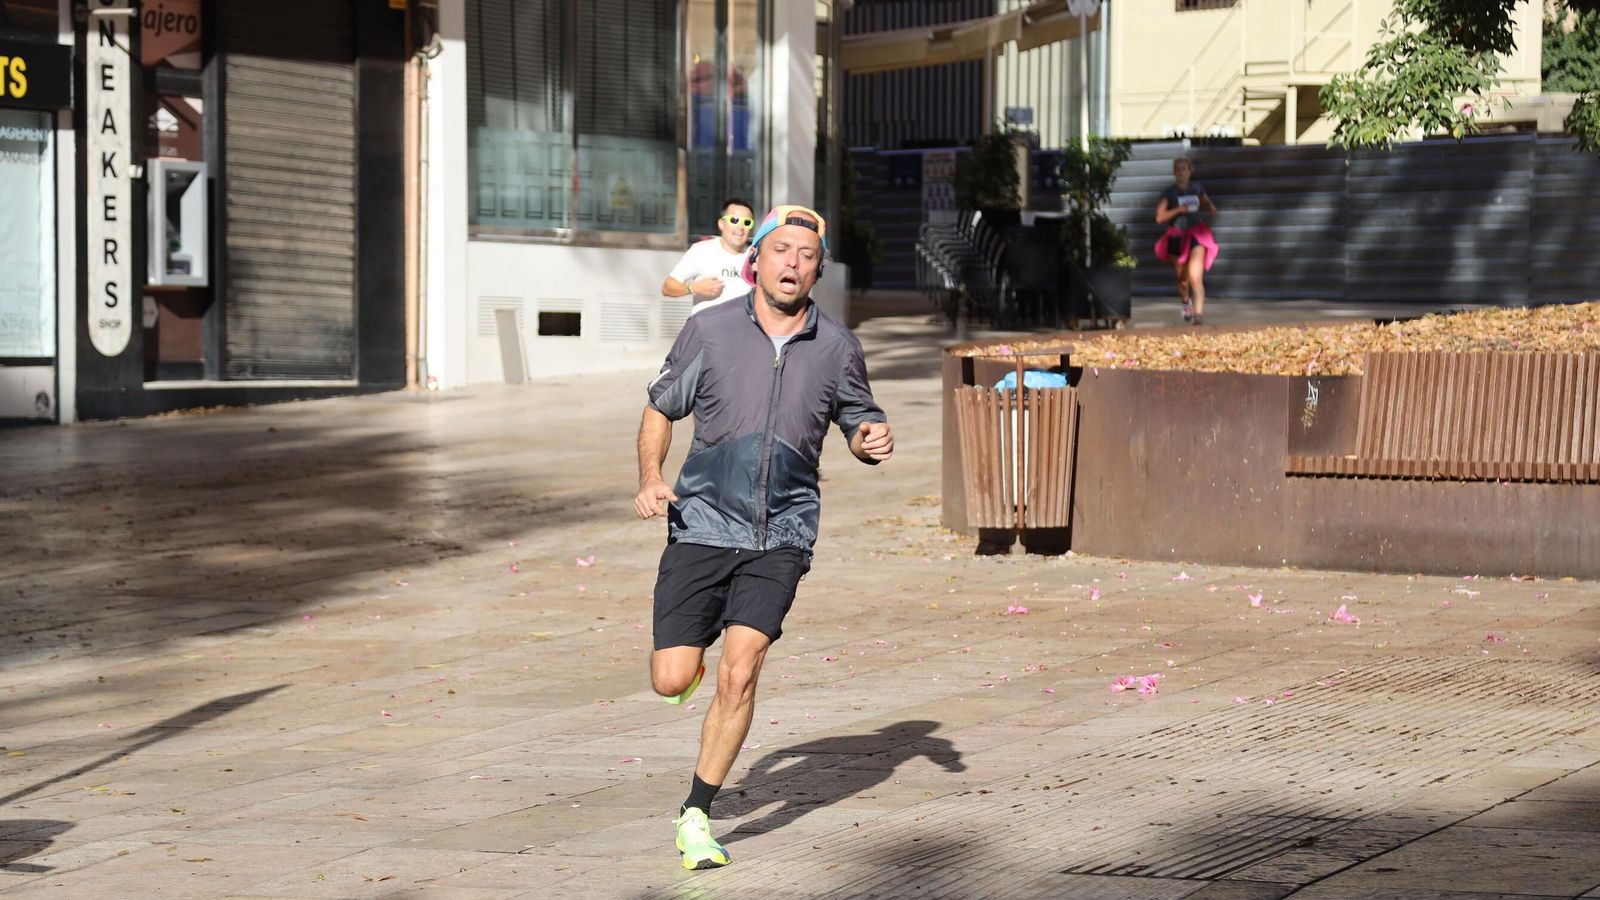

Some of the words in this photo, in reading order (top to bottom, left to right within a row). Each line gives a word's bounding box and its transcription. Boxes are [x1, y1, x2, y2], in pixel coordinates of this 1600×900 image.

[141, 3, 198, 36] ajero
[99, 0, 120, 308] NEAKERS
[721, 266, 741, 277] nik
[99, 319, 122, 329] SHOP
